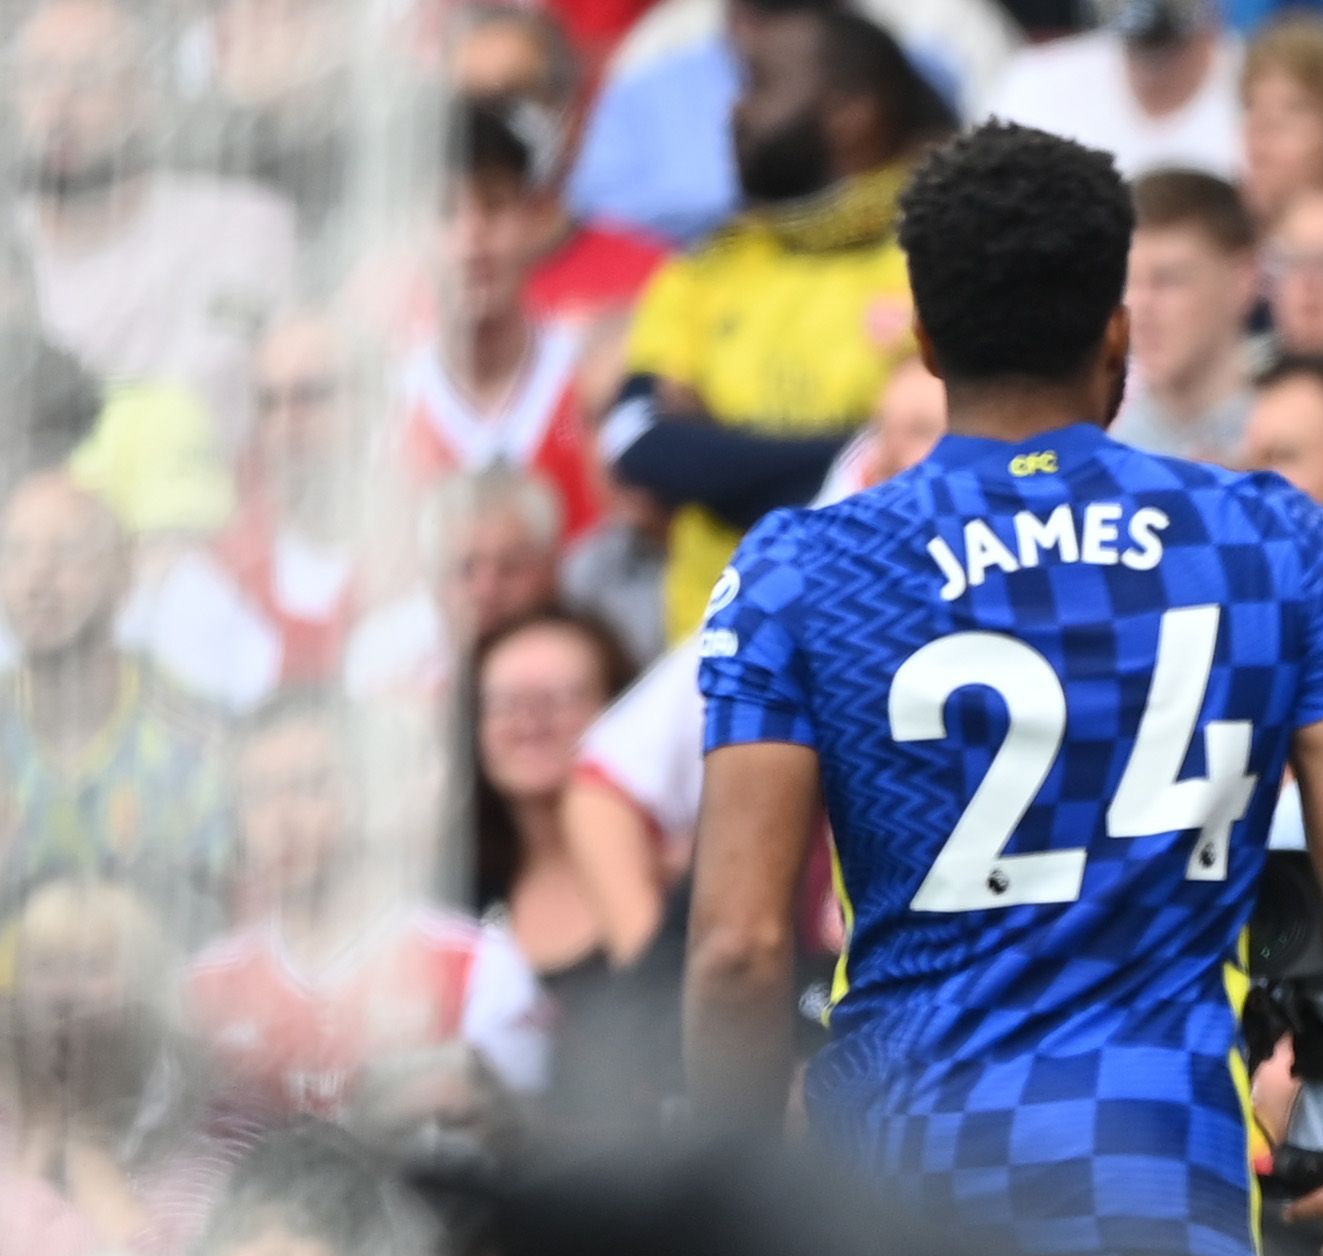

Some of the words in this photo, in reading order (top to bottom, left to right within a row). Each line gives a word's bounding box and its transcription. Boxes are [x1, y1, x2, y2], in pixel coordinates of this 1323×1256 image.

[1008, 450, 1058, 478] CFC
[926, 503, 1170, 602] JAMES
[888, 604, 1257, 911] 24
